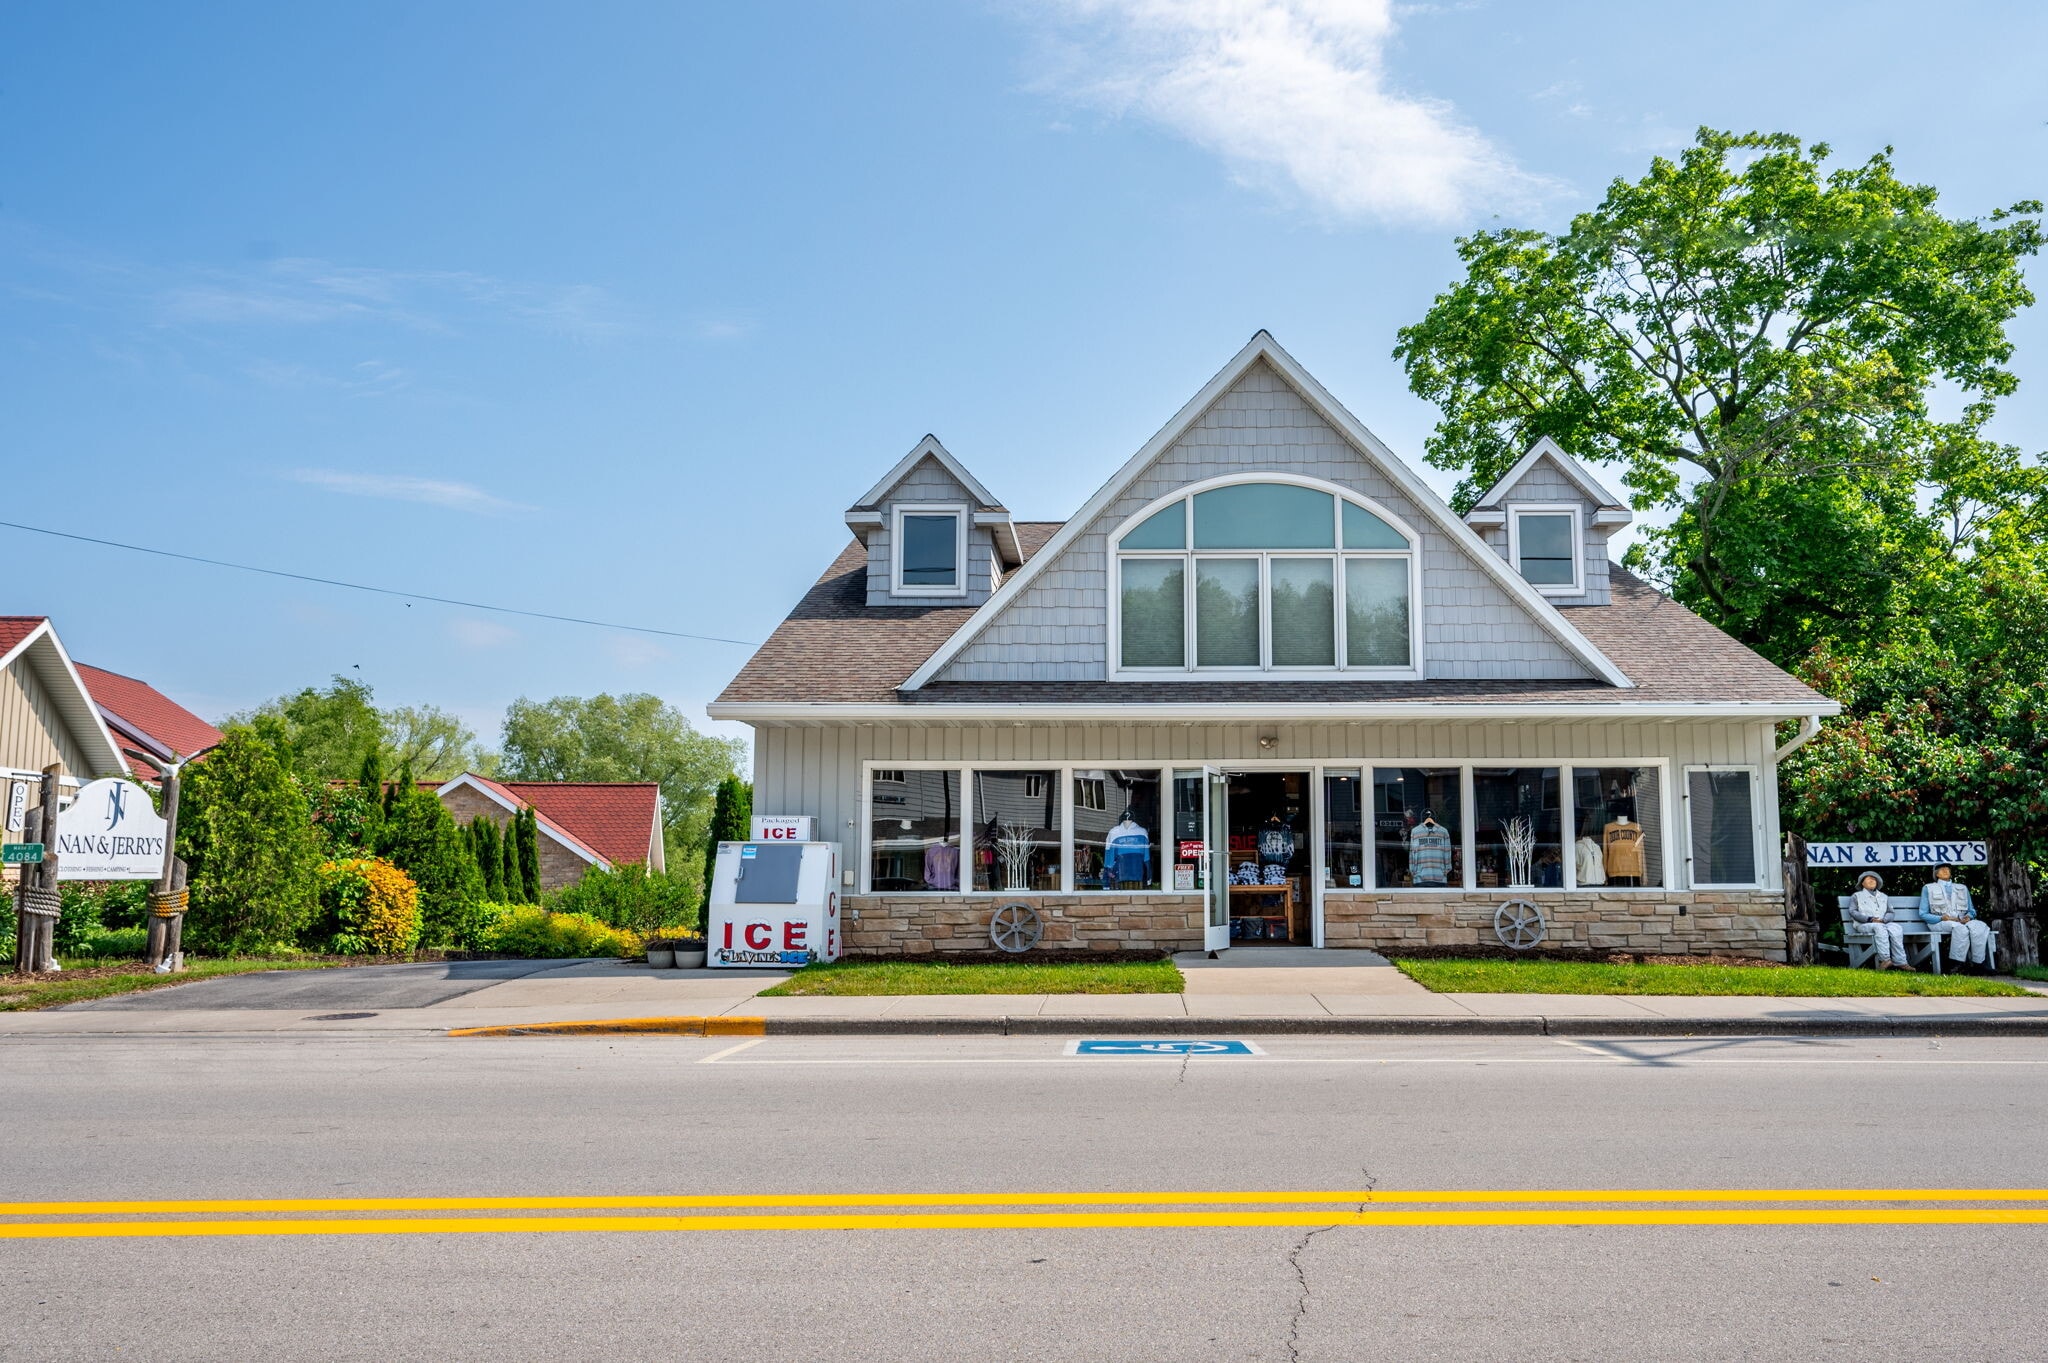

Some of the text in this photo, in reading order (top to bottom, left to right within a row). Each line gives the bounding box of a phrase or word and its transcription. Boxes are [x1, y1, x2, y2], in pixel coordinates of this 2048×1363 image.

[13, 785, 25, 828] OPEN
[763, 828, 797, 839] ICE
[8, 852, 37, 861] 4084
[57, 835, 163, 860] NAN & JERRY'S
[1807, 841, 1986, 863] NAN & JERRY'S
[828, 852, 836, 957] ICE
[723, 917, 808, 950] ICE
[780, 951, 809, 964] ICE
